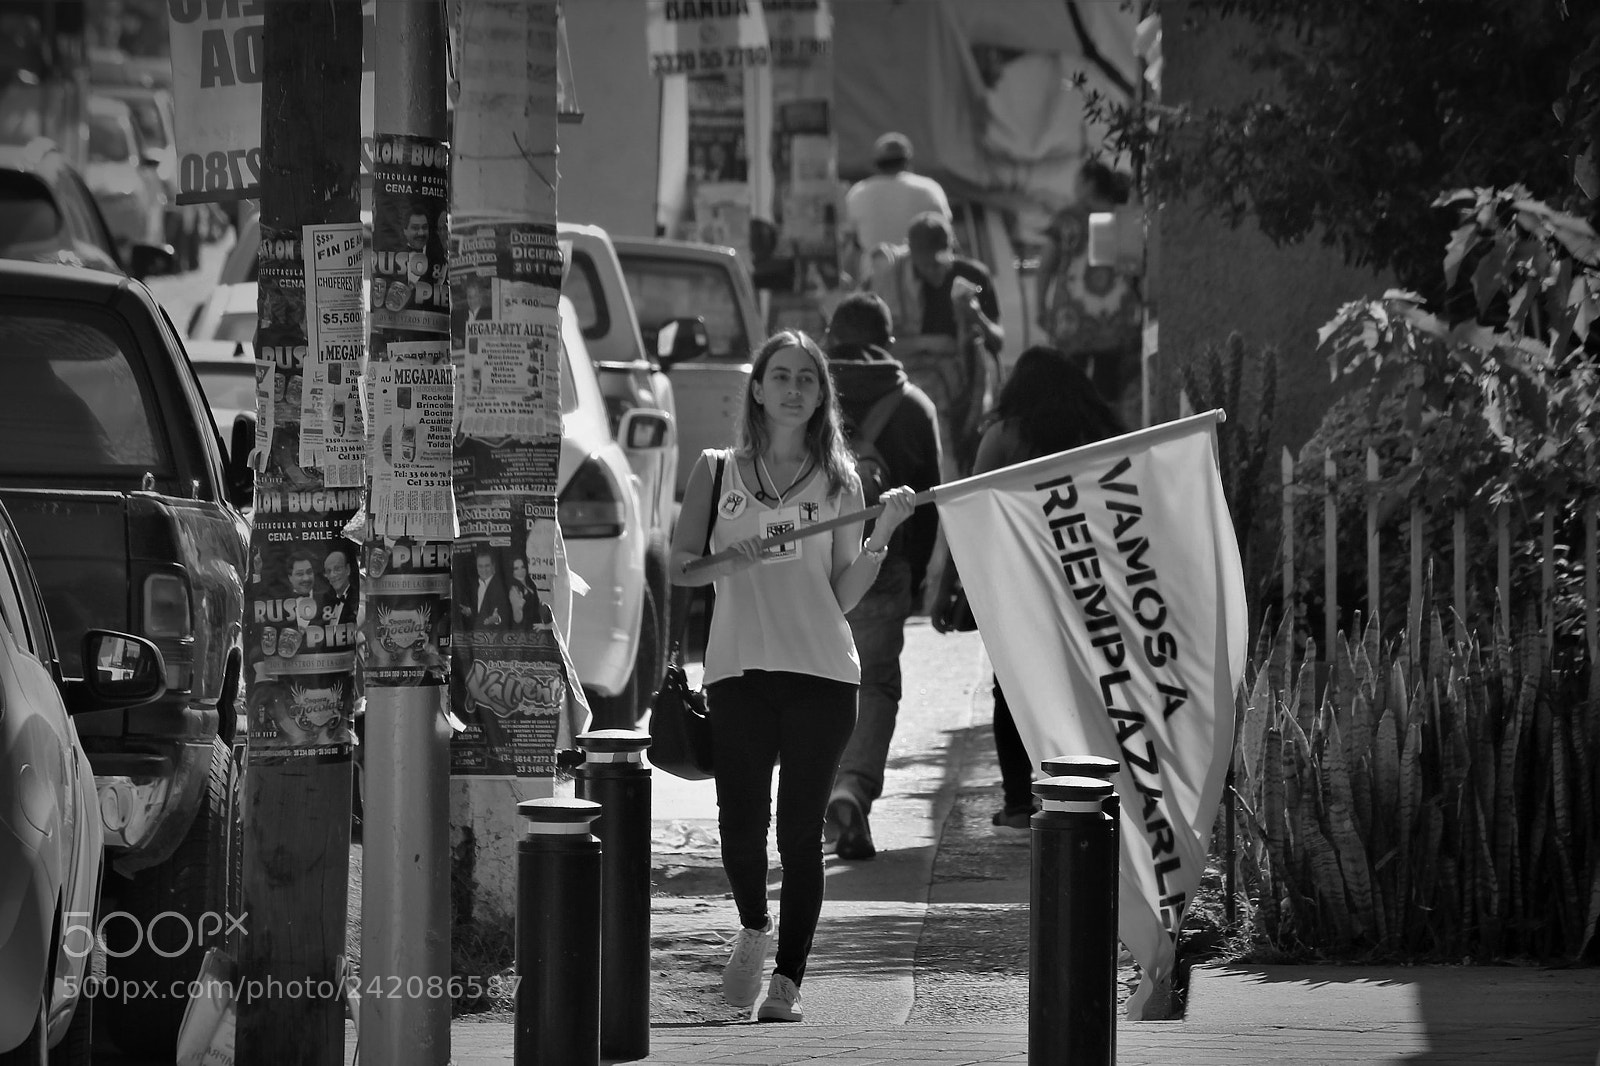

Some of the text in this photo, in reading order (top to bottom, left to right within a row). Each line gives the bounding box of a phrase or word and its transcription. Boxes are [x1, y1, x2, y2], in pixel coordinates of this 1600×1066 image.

[385, 183, 413, 194] CENA
[421, 186, 444, 198] BAILE
[317, 243, 341, 260] FIN
[343, 237, 355, 251] DE
[317, 276, 353, 292] CHOFERES
[322, 312, 360, 326] $5,500
[467, 322, 545, 338] MEGAPARTY ALEX
[394, 470, 408, 478] Tel:
[407, 478, 422, 486] Cel
[424, 479, 435, 487] 33
[524, 503, 555, 518] DOMIN
[301, 520, 329, 529] NOCHE
[267, 532, 294, 542] CENA
[301, 530, 333, 541] BAILE
[1098, 456, 1189, 724] VAMOS A
[254, 597, 317, 624] RUSO
